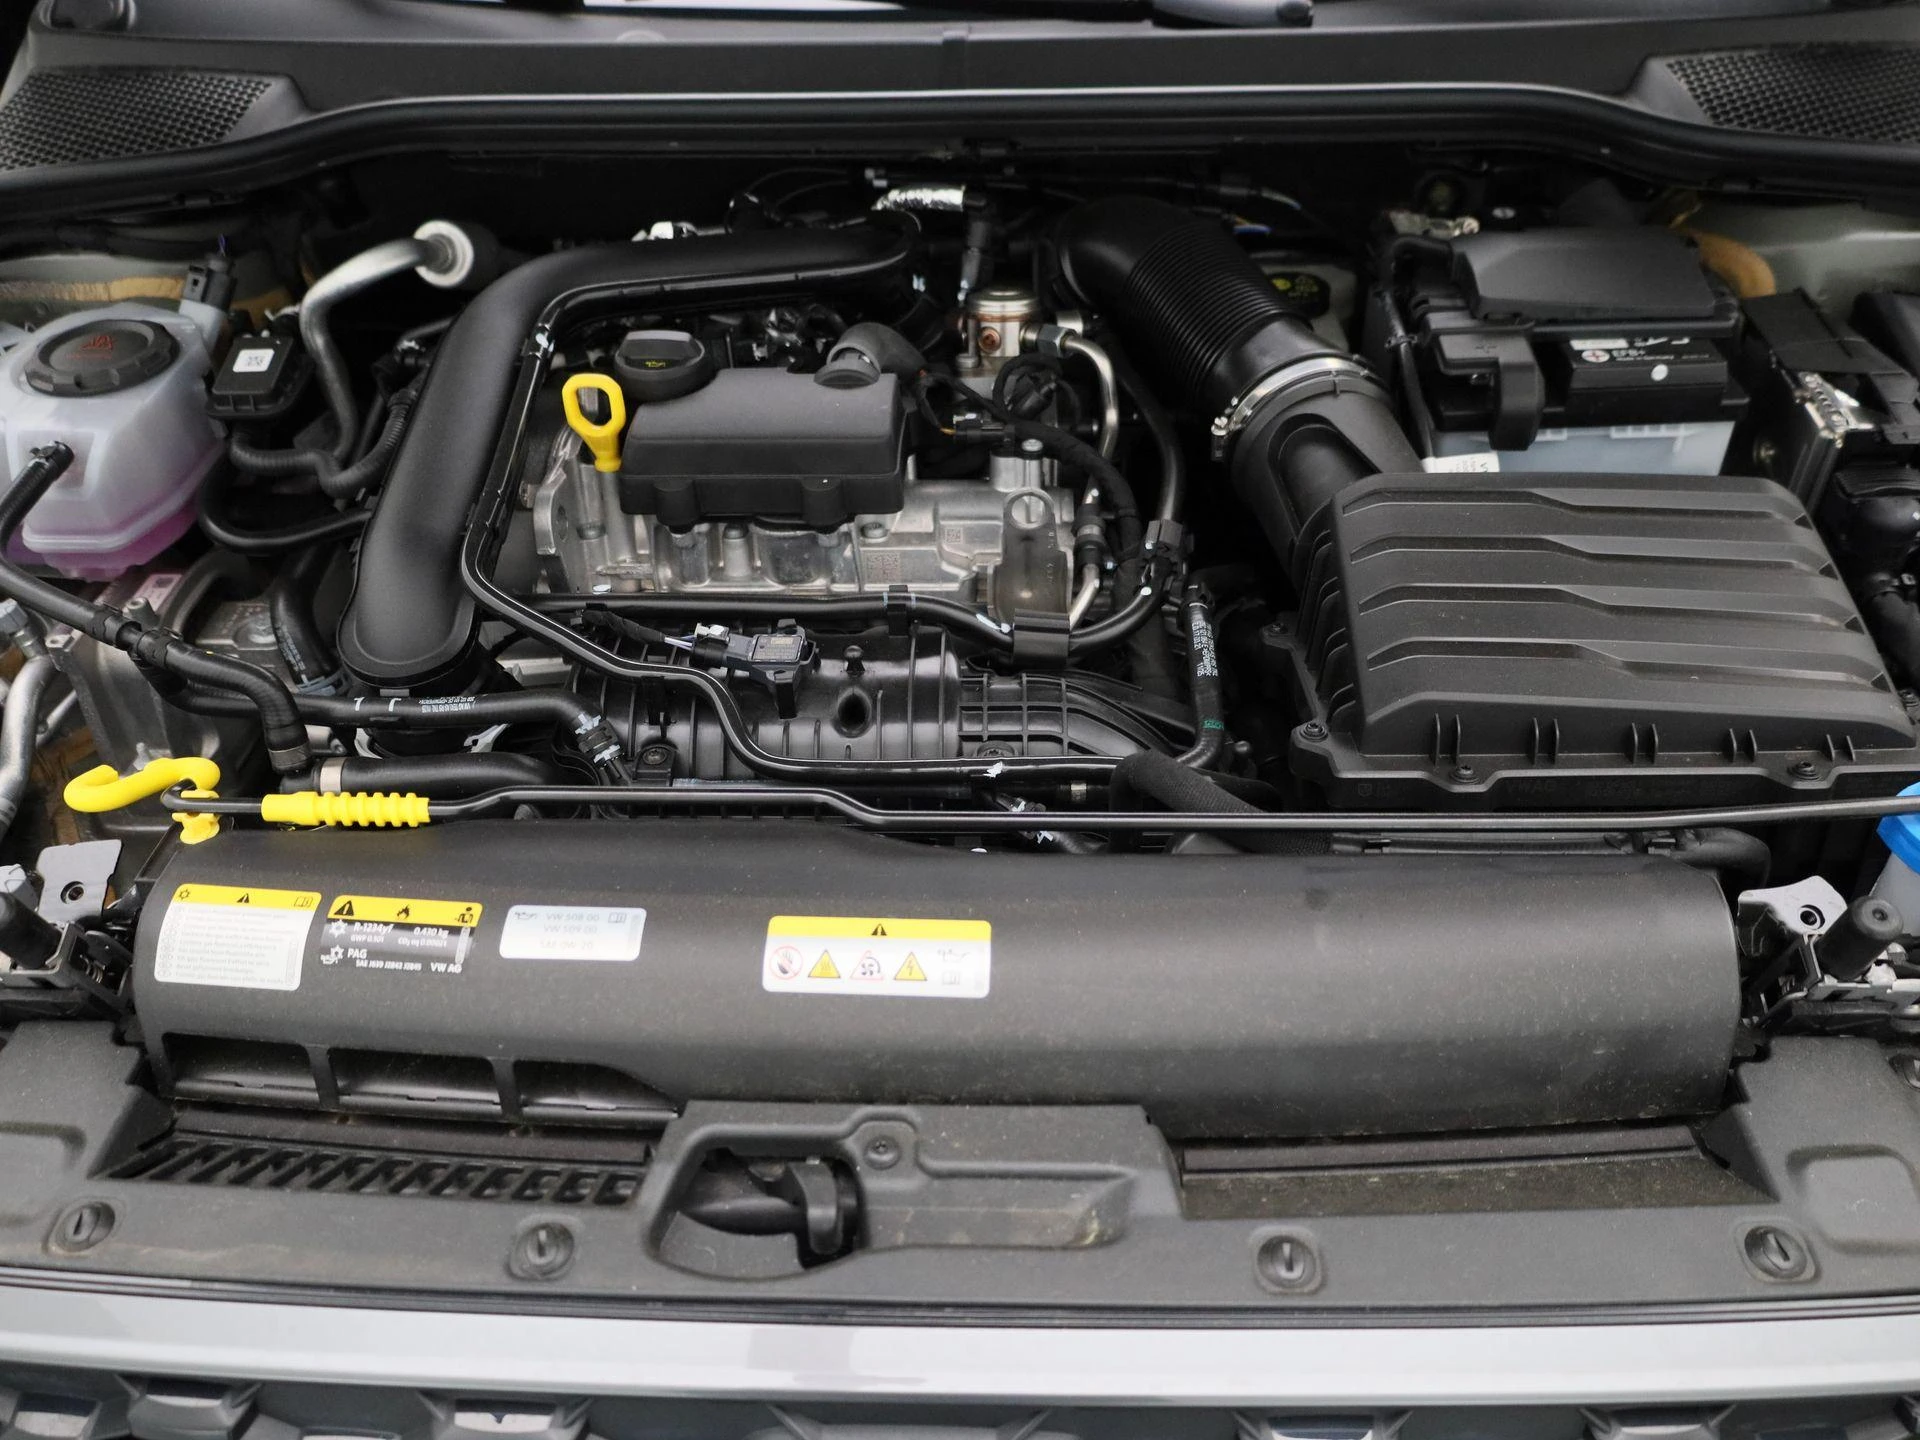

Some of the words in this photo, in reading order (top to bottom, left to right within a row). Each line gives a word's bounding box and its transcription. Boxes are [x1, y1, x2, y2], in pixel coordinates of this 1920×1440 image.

[353, 922, 394, 935] R-1234yf
[438, 928, 449, 940] kg
[347, 948, 368, 960] PAG
[430, 962, 448, 973] VW
[447, 964, 462, 974] AG
